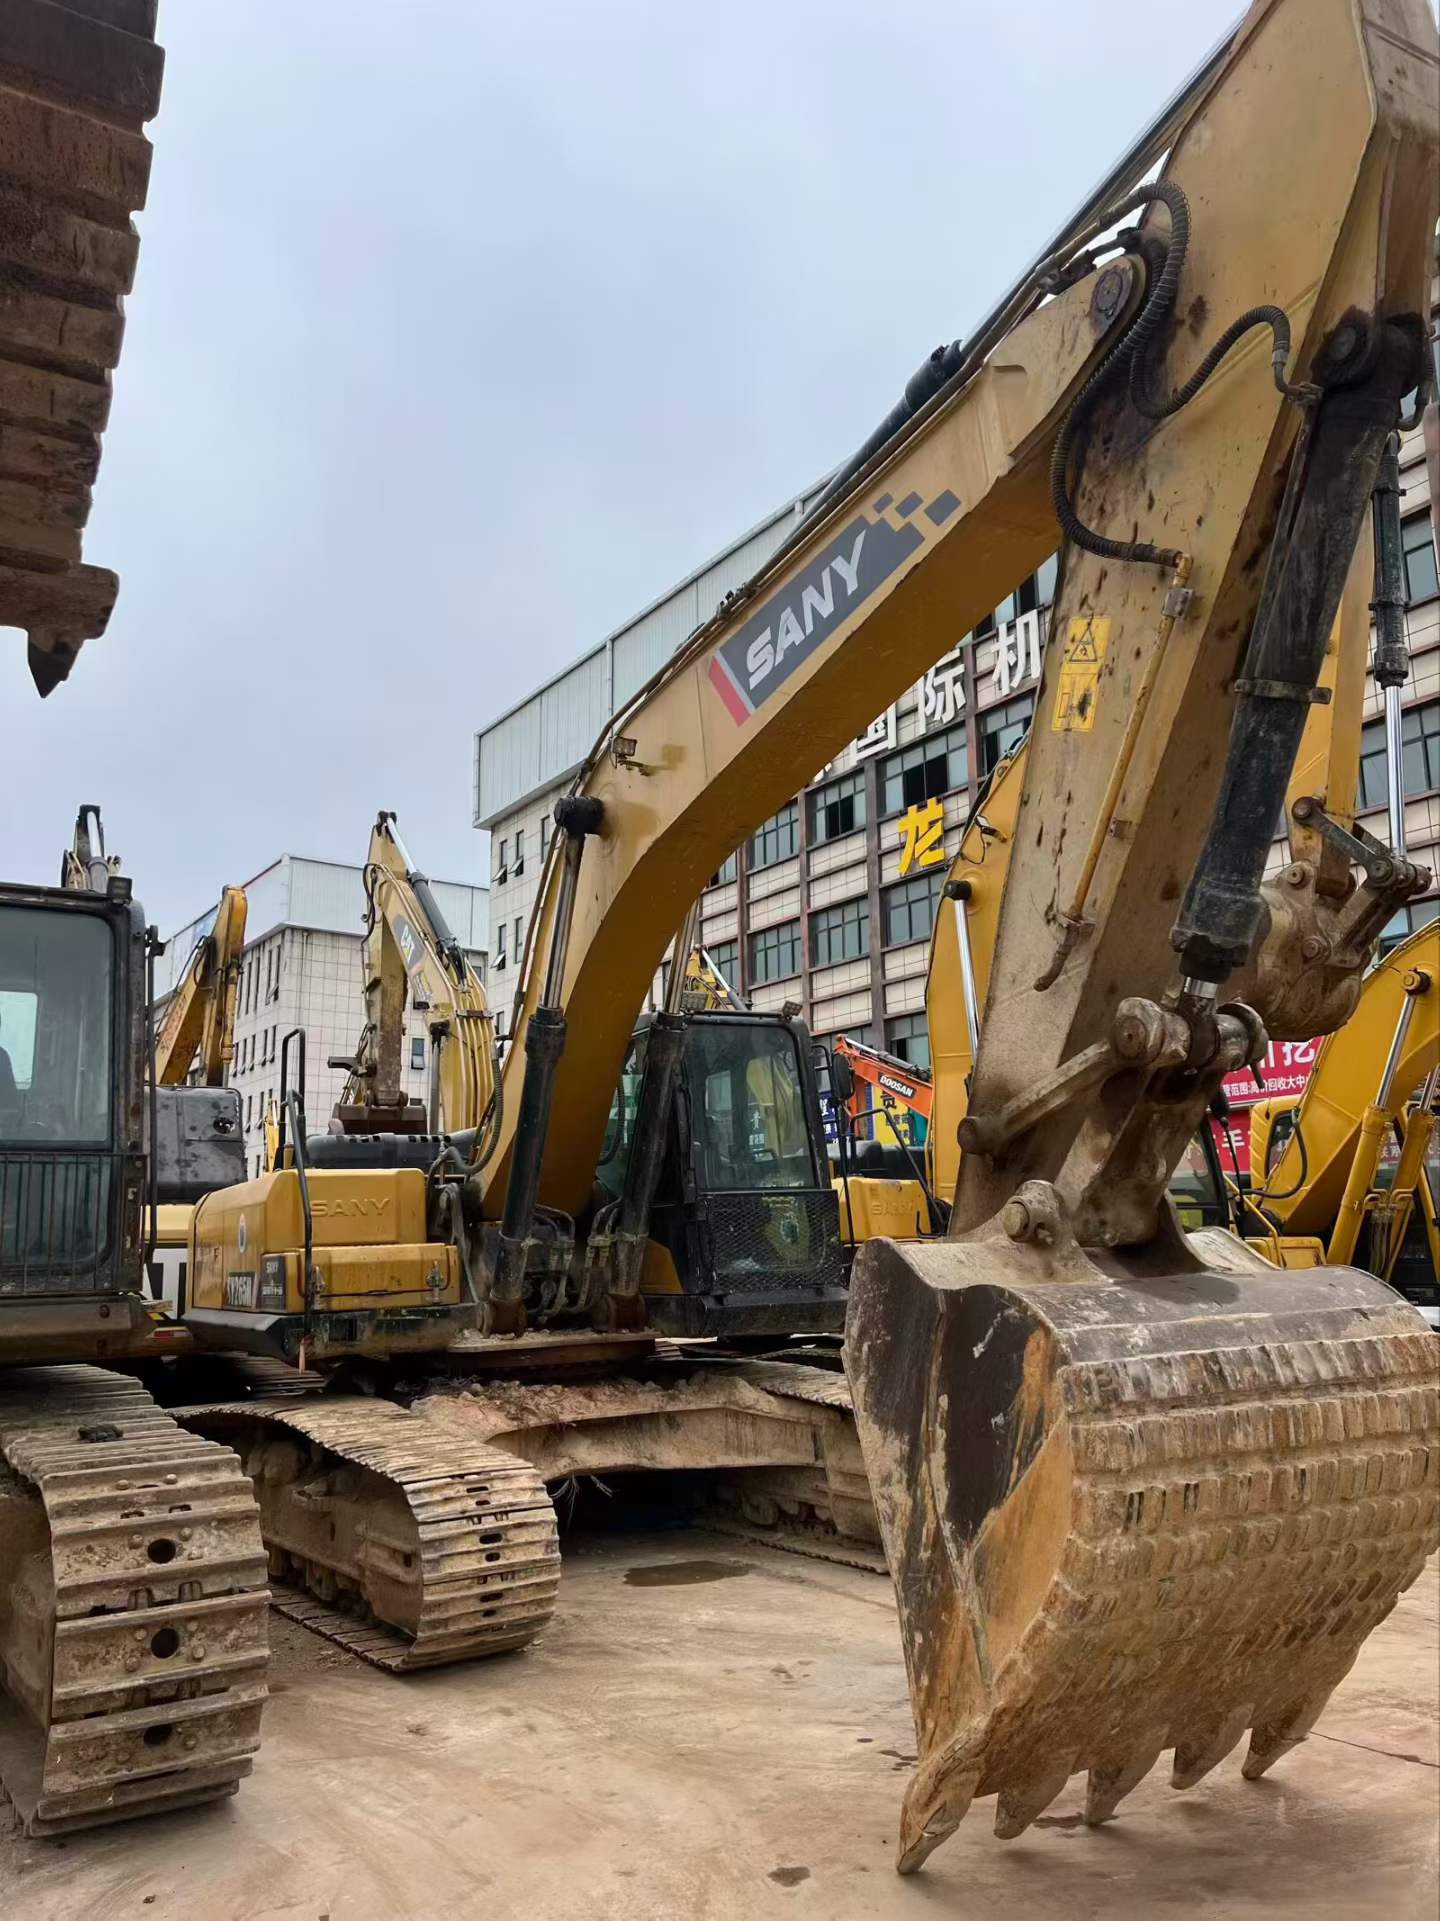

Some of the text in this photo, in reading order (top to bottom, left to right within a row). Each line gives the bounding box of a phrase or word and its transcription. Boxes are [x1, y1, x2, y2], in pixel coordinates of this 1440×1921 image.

[746, 529, 867, 690] SANY
[897, 798, 945, 877] 龙
[880, 1075, 914, 1097] DOOSAN
[310, 1198, 390, 1217] SANY
